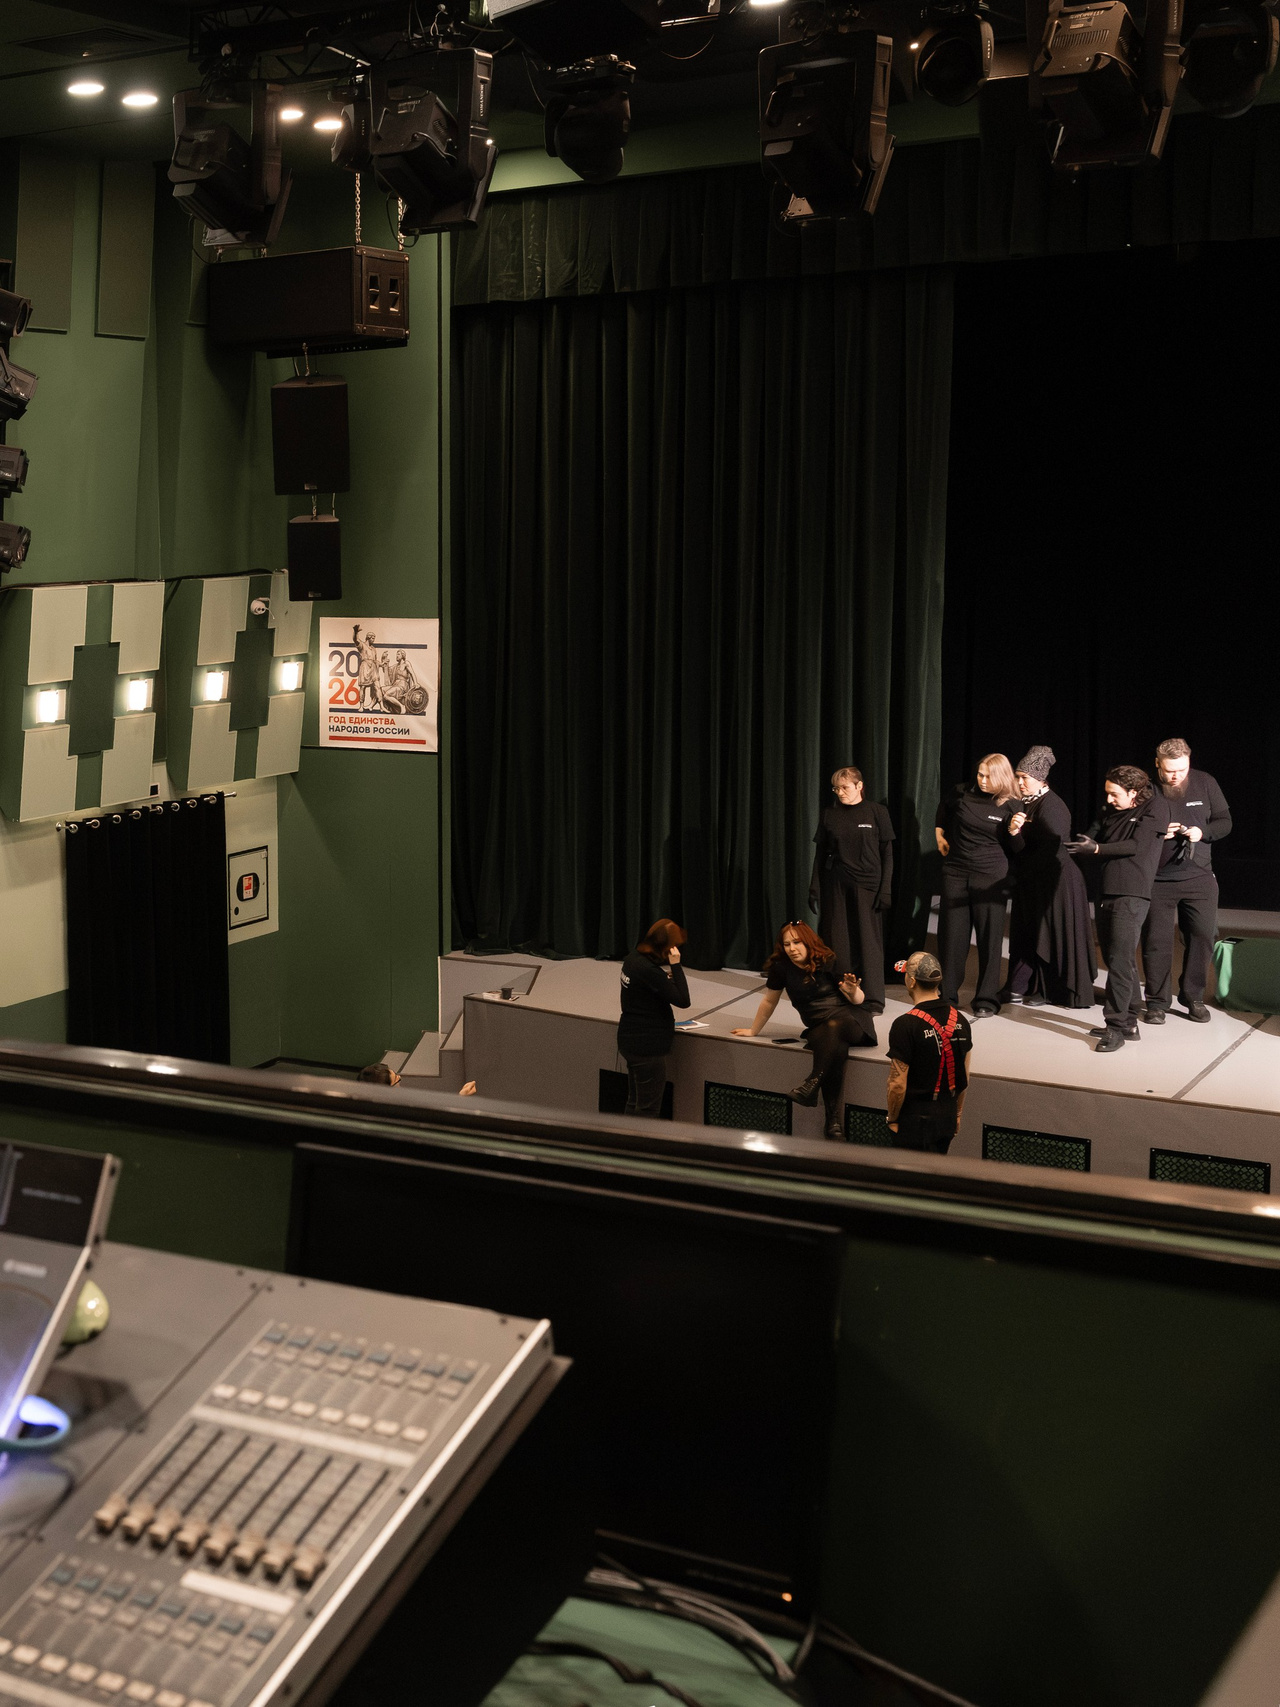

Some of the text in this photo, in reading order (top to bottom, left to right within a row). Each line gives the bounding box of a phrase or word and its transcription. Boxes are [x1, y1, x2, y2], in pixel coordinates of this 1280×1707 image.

[328, 650, 361, 677] 20
[328, 678, 360, 706] 26
[328, 716, 396, 726] ГОД ЕДИНСТВА
[328, 725, 410, 735] НАРОДОВ РОССИИ
